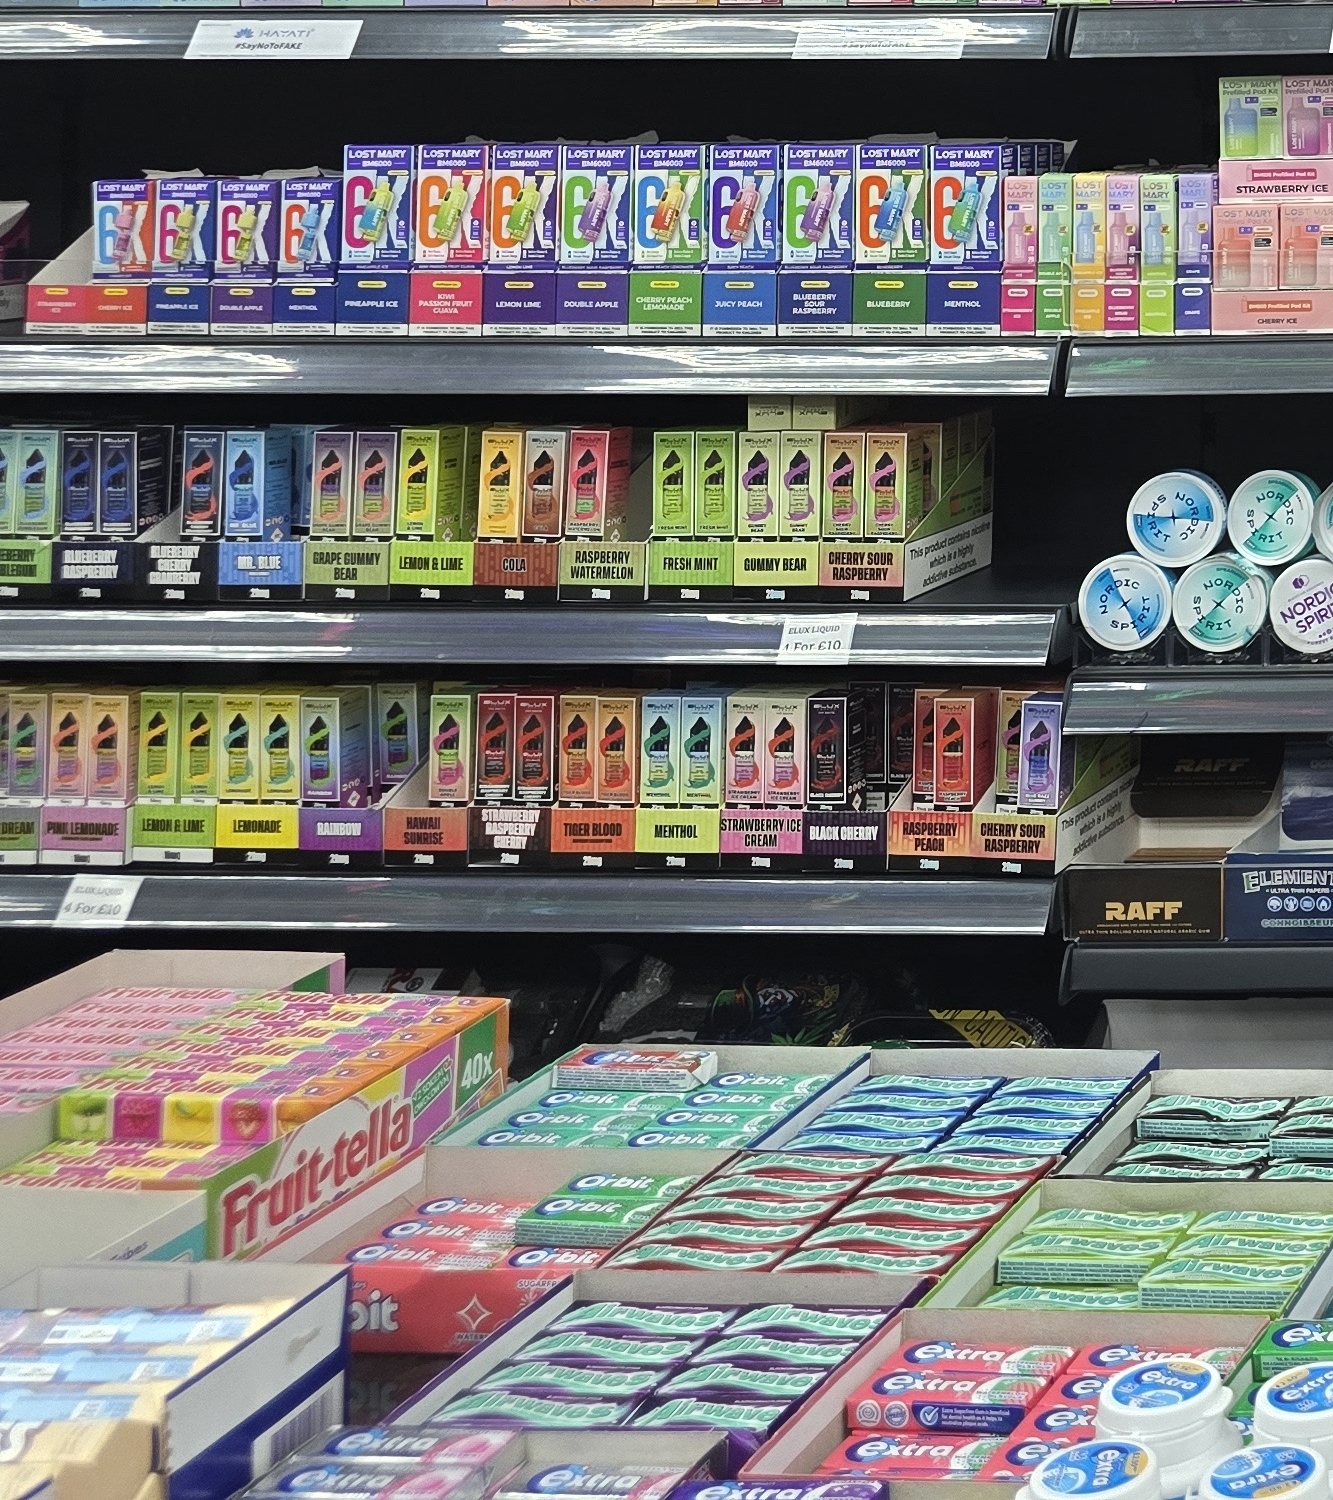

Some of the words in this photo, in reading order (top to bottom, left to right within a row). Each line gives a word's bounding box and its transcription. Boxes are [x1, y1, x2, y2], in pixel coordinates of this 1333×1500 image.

[235, 42, 302, 50] #SayNoToFAKE
[348, 149, 378, 158] LOST
[380, 149, 408, 158] MARY
[1236, 183, 1311, 194] STRAWBERRY
[1314, 183, 1329, 194] ICE
[564, 300, 590, 308] DOUBLE
[593, 300, 619, 308] APPLE
[575, 550, 630, 564] RASPBERRY
[663, 557, 691, 571] FRESH
[694, 556, 719, 571] MINT
[570, 565, 634, 580] WATERMELON
[743, 557, 780, 573] GUMMY
[783, 557, 807, 572] BEAR
[788, 626, 809, 635] ELUX
[811, 625, 840, 635] LIQUID
[563, 822, 590, 837] TIGER
[592, 822, 623, 837] BLOOD
[1105, 901, 1182, 921] RAFF
[461, 1052, 493, 1090] 40x
[221, 1102, 413, 1259] Fruit-tella
[1056, 1210, 1178, 1232] Airwaves
[355, 1245, 431, 1262] Orbit
